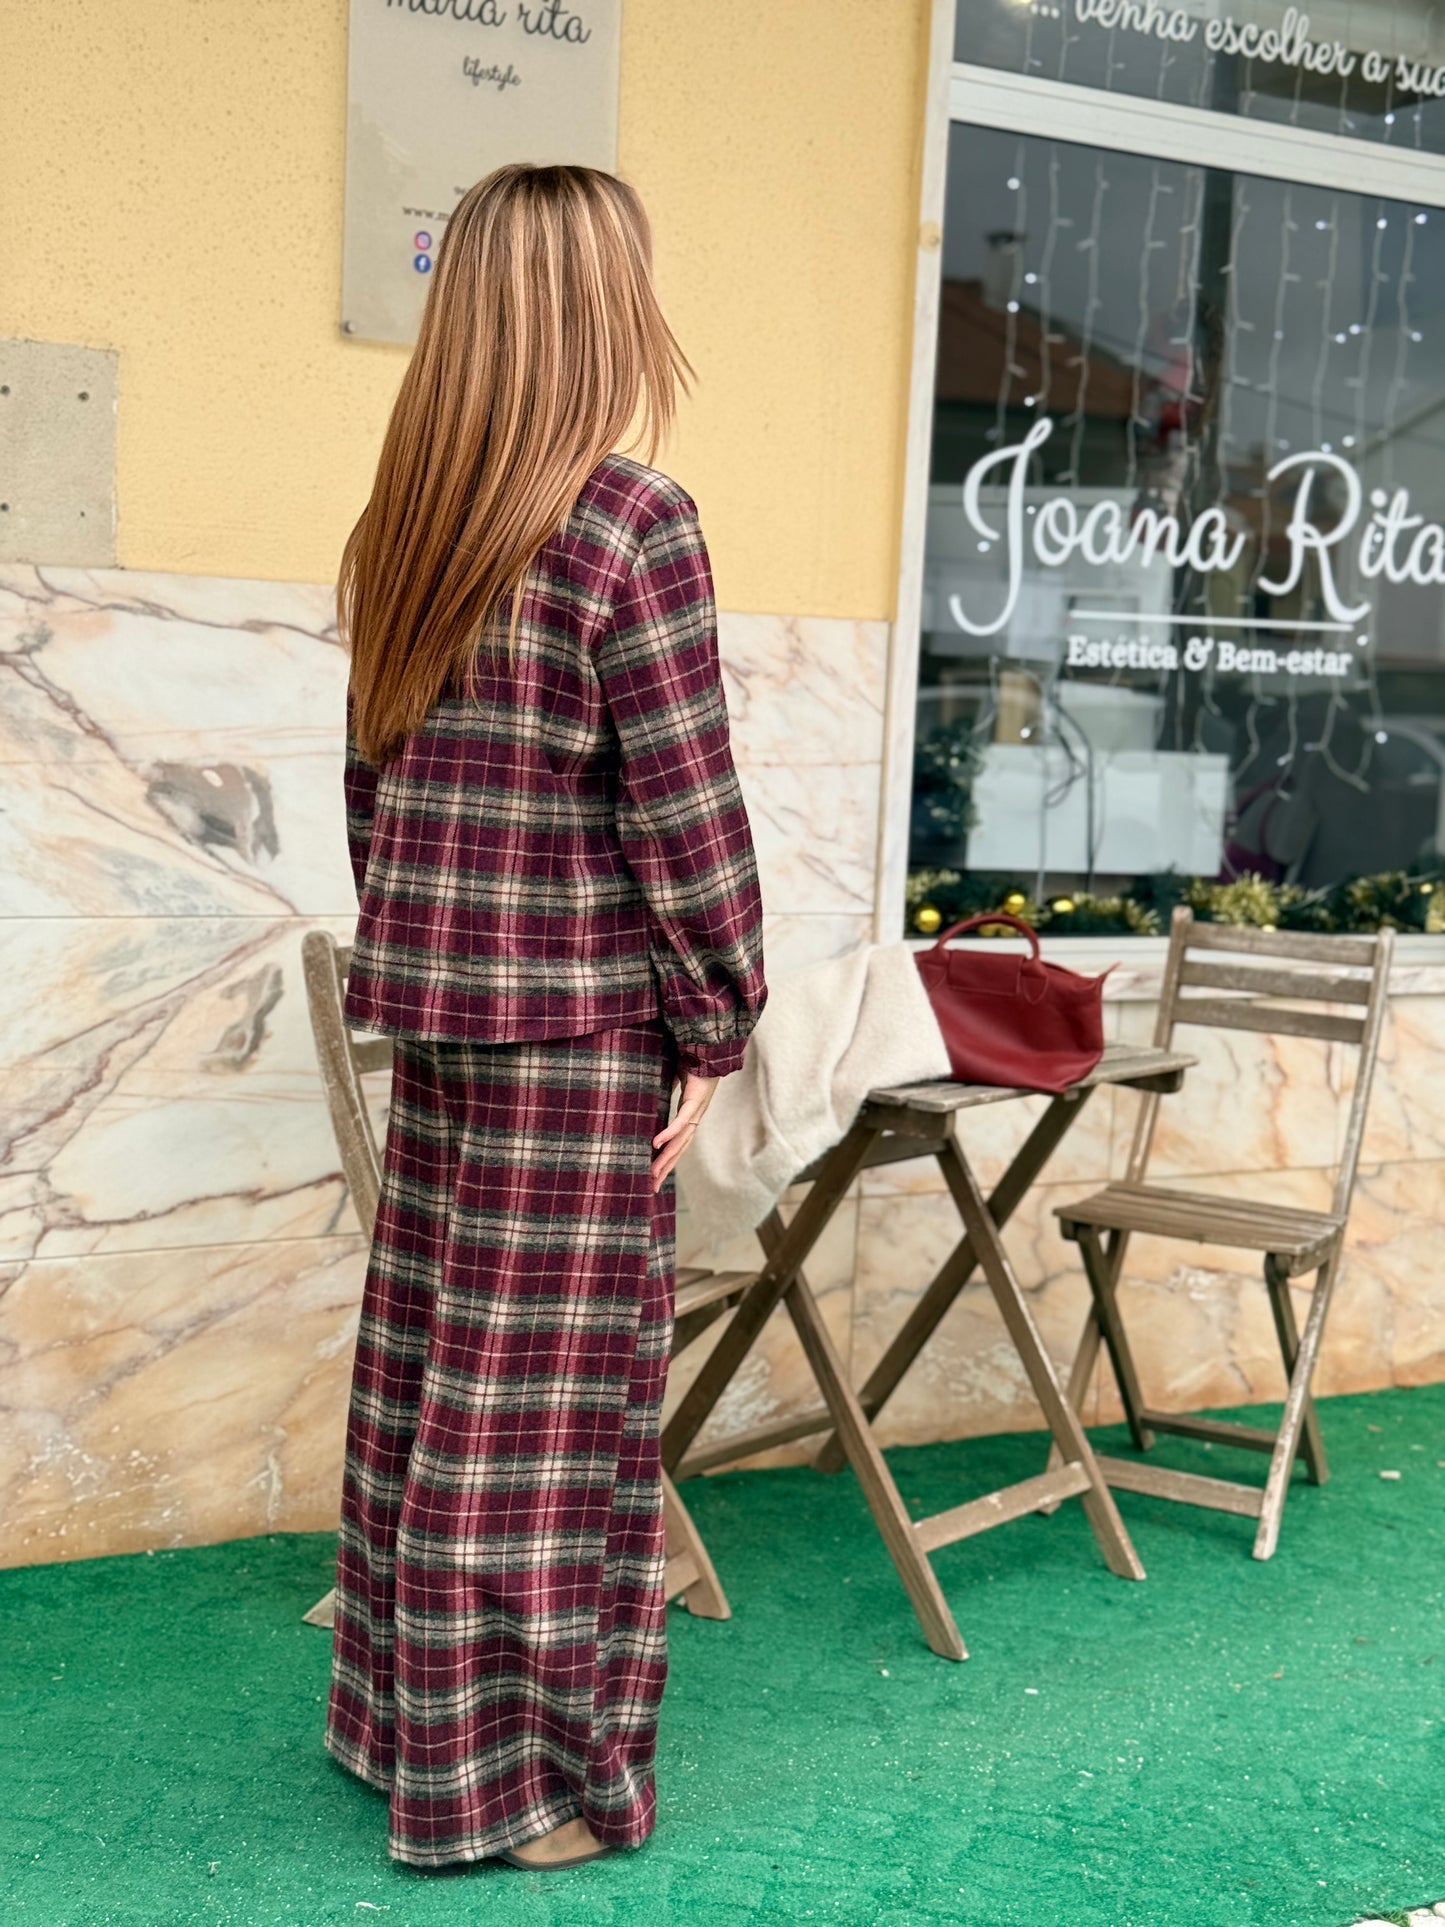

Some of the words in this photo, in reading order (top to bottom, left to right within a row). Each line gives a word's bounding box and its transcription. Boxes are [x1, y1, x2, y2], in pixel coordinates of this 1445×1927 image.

[518, 0, 592, 44] rita
[1075, 0, 1198, 42] venha
[1205, 6, 1356, 76] escolher
[1361, 50, 1391, 82] a
[462, 56, 521, 91] lifestyle
[949, 417, 1246, 636] Joana
[1257, 451, 1445, 623] Rita
[1067, 635, 1178, 670] Estética
[1184, 637, 1214, 671] &
[1216, 641, 1353, 676] Bem-estar
